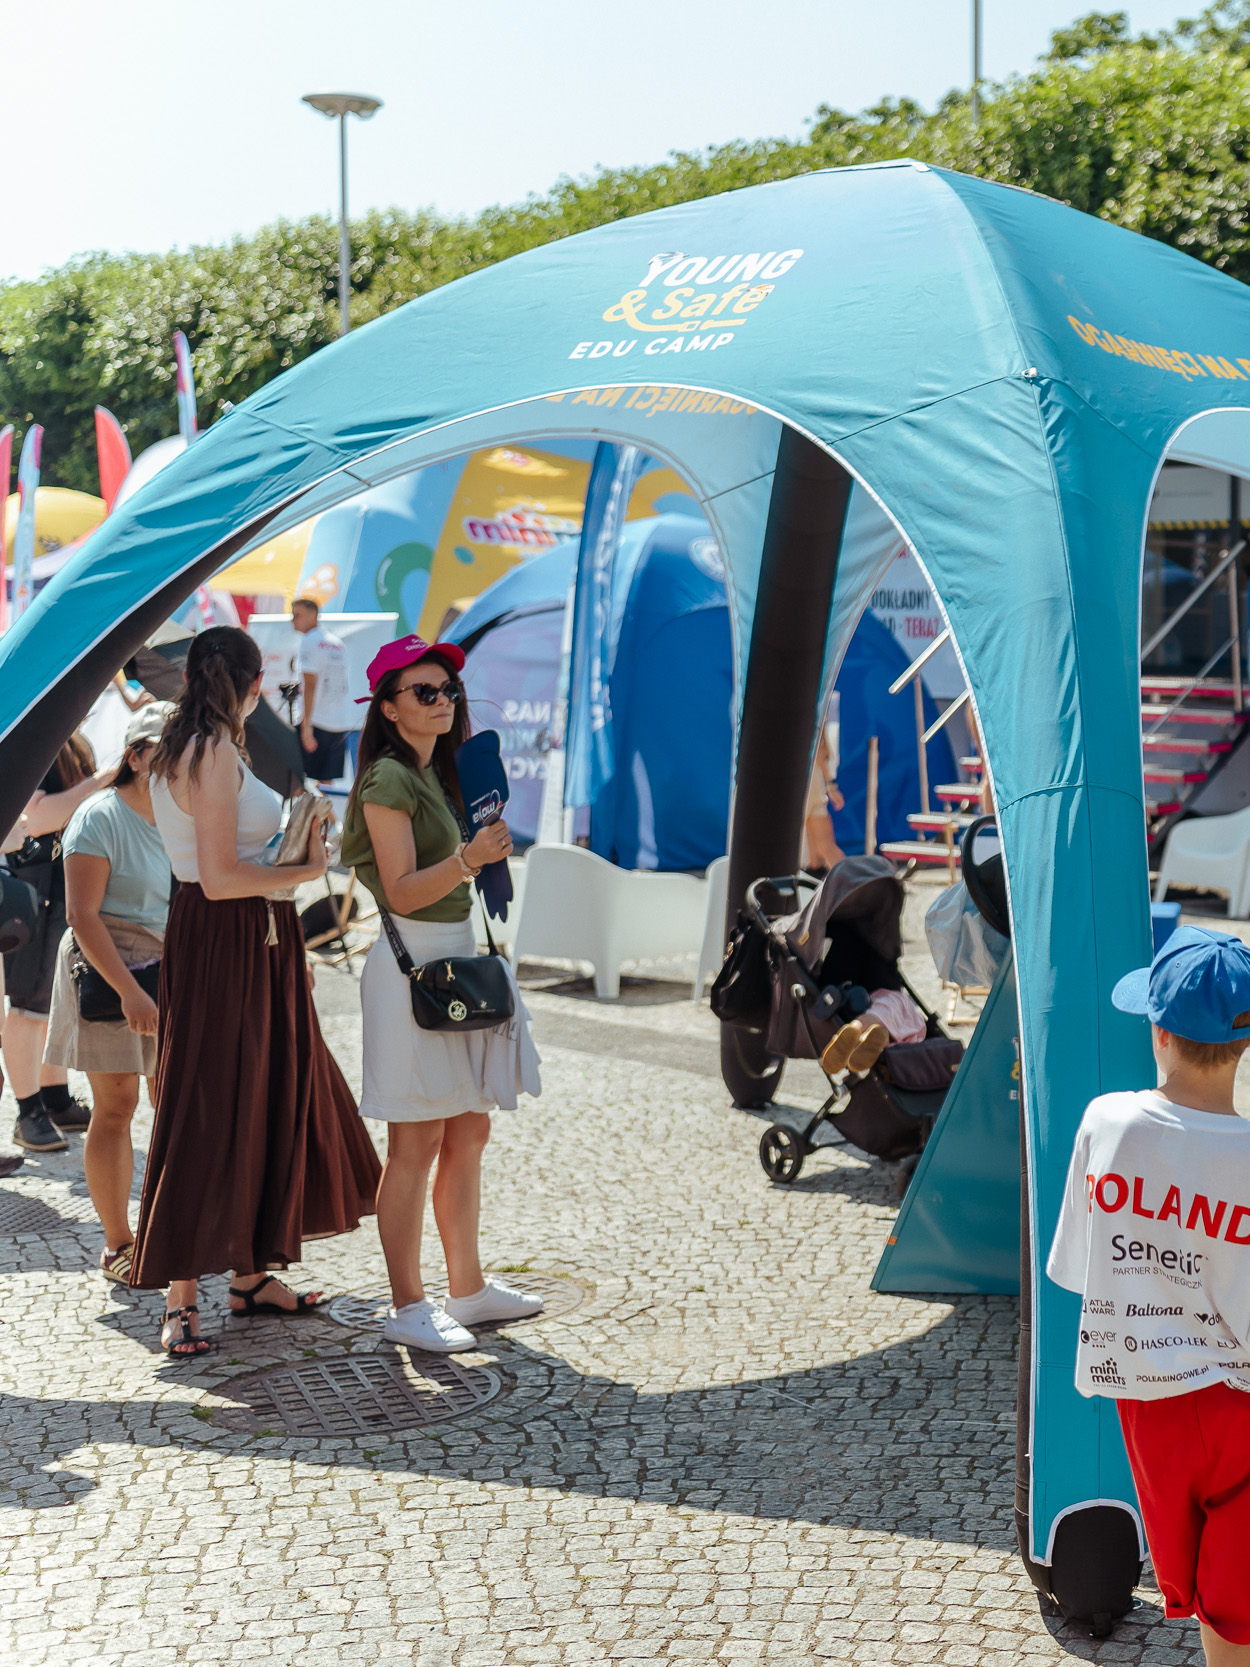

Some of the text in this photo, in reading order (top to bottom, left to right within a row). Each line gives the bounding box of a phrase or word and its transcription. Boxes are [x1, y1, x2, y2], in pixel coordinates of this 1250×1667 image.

[638, 249, 804, 287] YOUNG
[651, 283, 773, 320] Safe
[568, 333, 734, 359] EDU CAMP
[1067, 315, 1208, 382] OGARNIĘCI
[1203, 354, 1248, 381] NA
[1112, 1266, 1151, 1276] PARTNER
[1090, 1299, 1115, 1308] ATLAS
[1126, 1303, 1184, 1317] Baltona
[1090, 1307, 1116, 1316] WARD
[1090, 1330, 1117, 1342] ever
[1141, 1336, 1208, 1350] HASCO-LEK
[1090, 1361, 1118, 1375] mini
